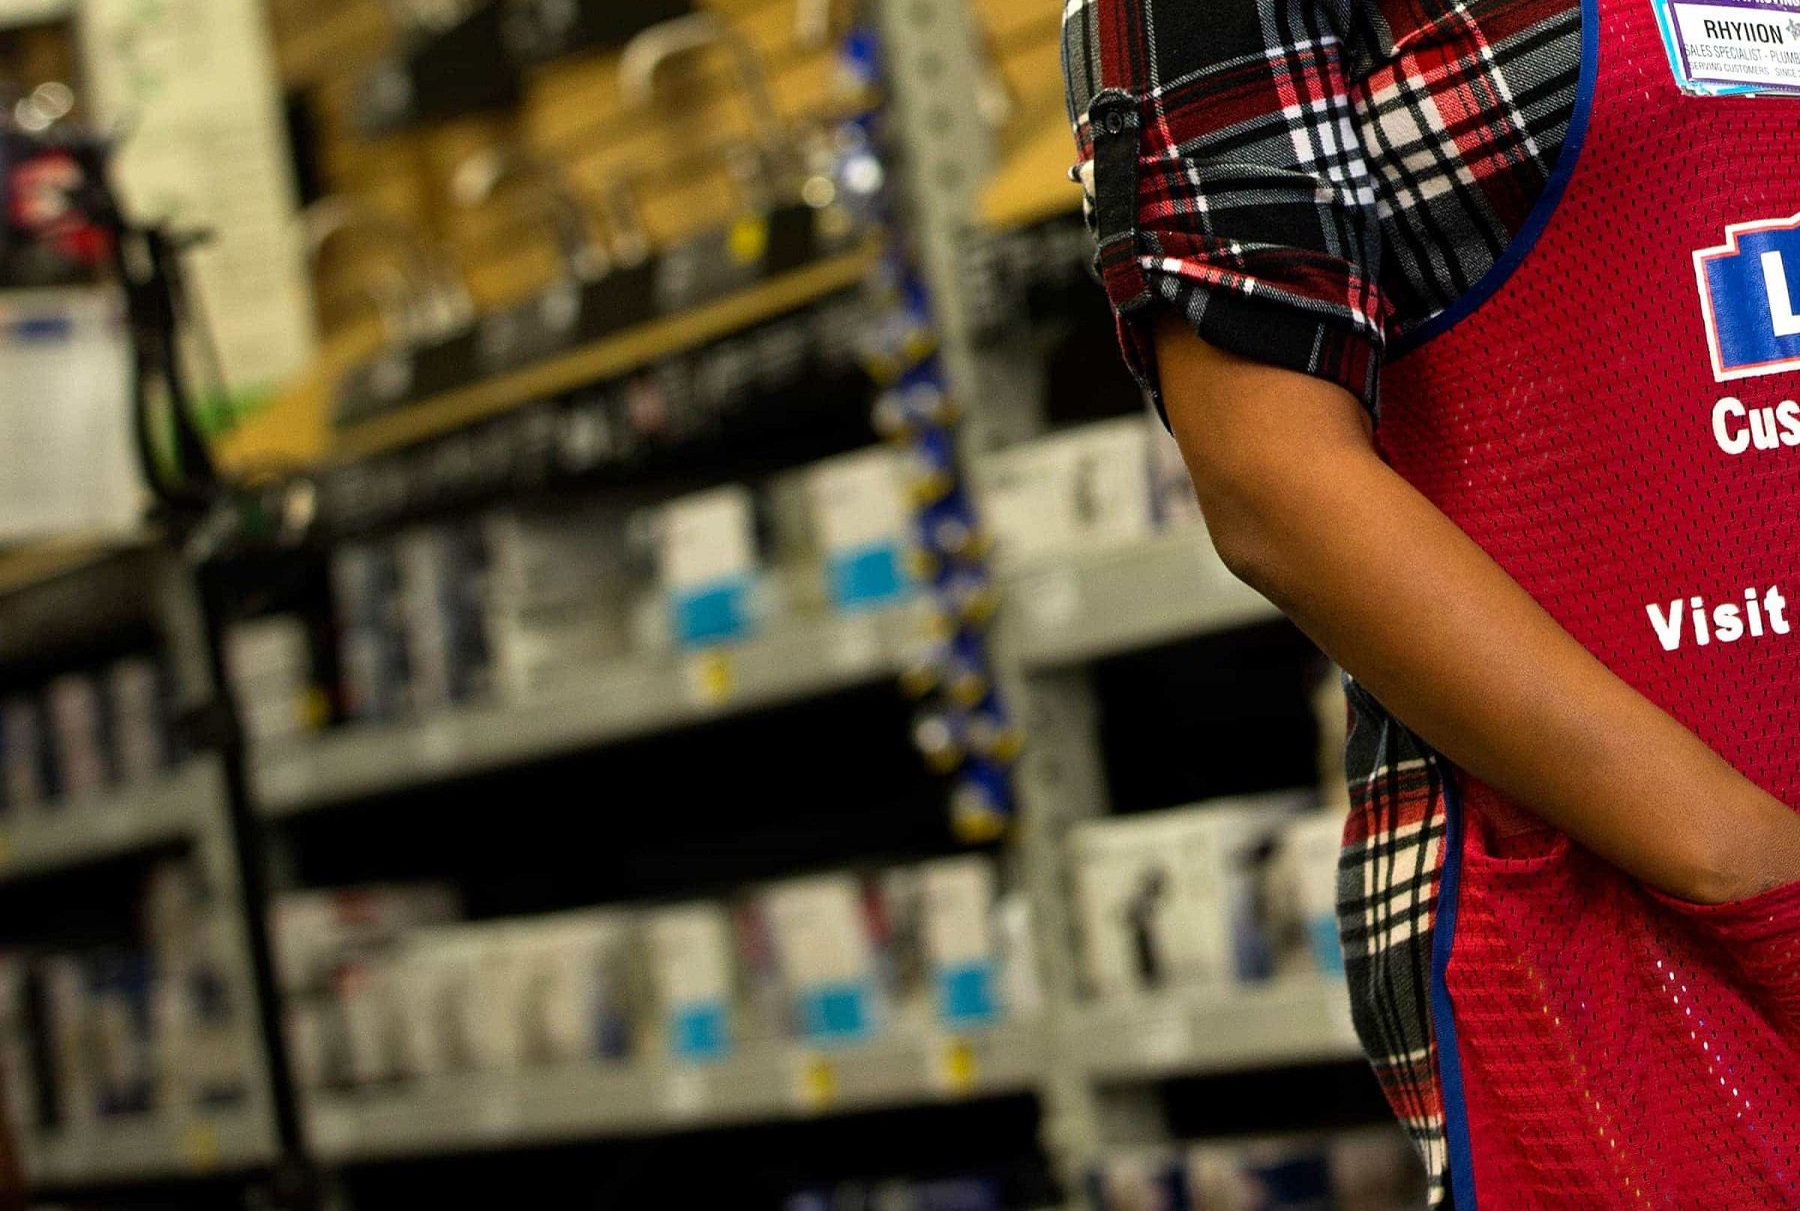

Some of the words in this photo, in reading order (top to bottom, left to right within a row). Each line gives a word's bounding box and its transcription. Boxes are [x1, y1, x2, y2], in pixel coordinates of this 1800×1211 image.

[1703, 19, 1784, 45] RHYIION
[1685, 43, 1713, 59] SALES
[1713, 45, 1763, 61] SPECIALIST
[1690, 61, 1722, 71] SERVING
[1723, 63, 1770, 76] CUSTOMERS
[1774, 67, 1799, 78] SINCE
[1645, 584, 1791, 651] Visit
